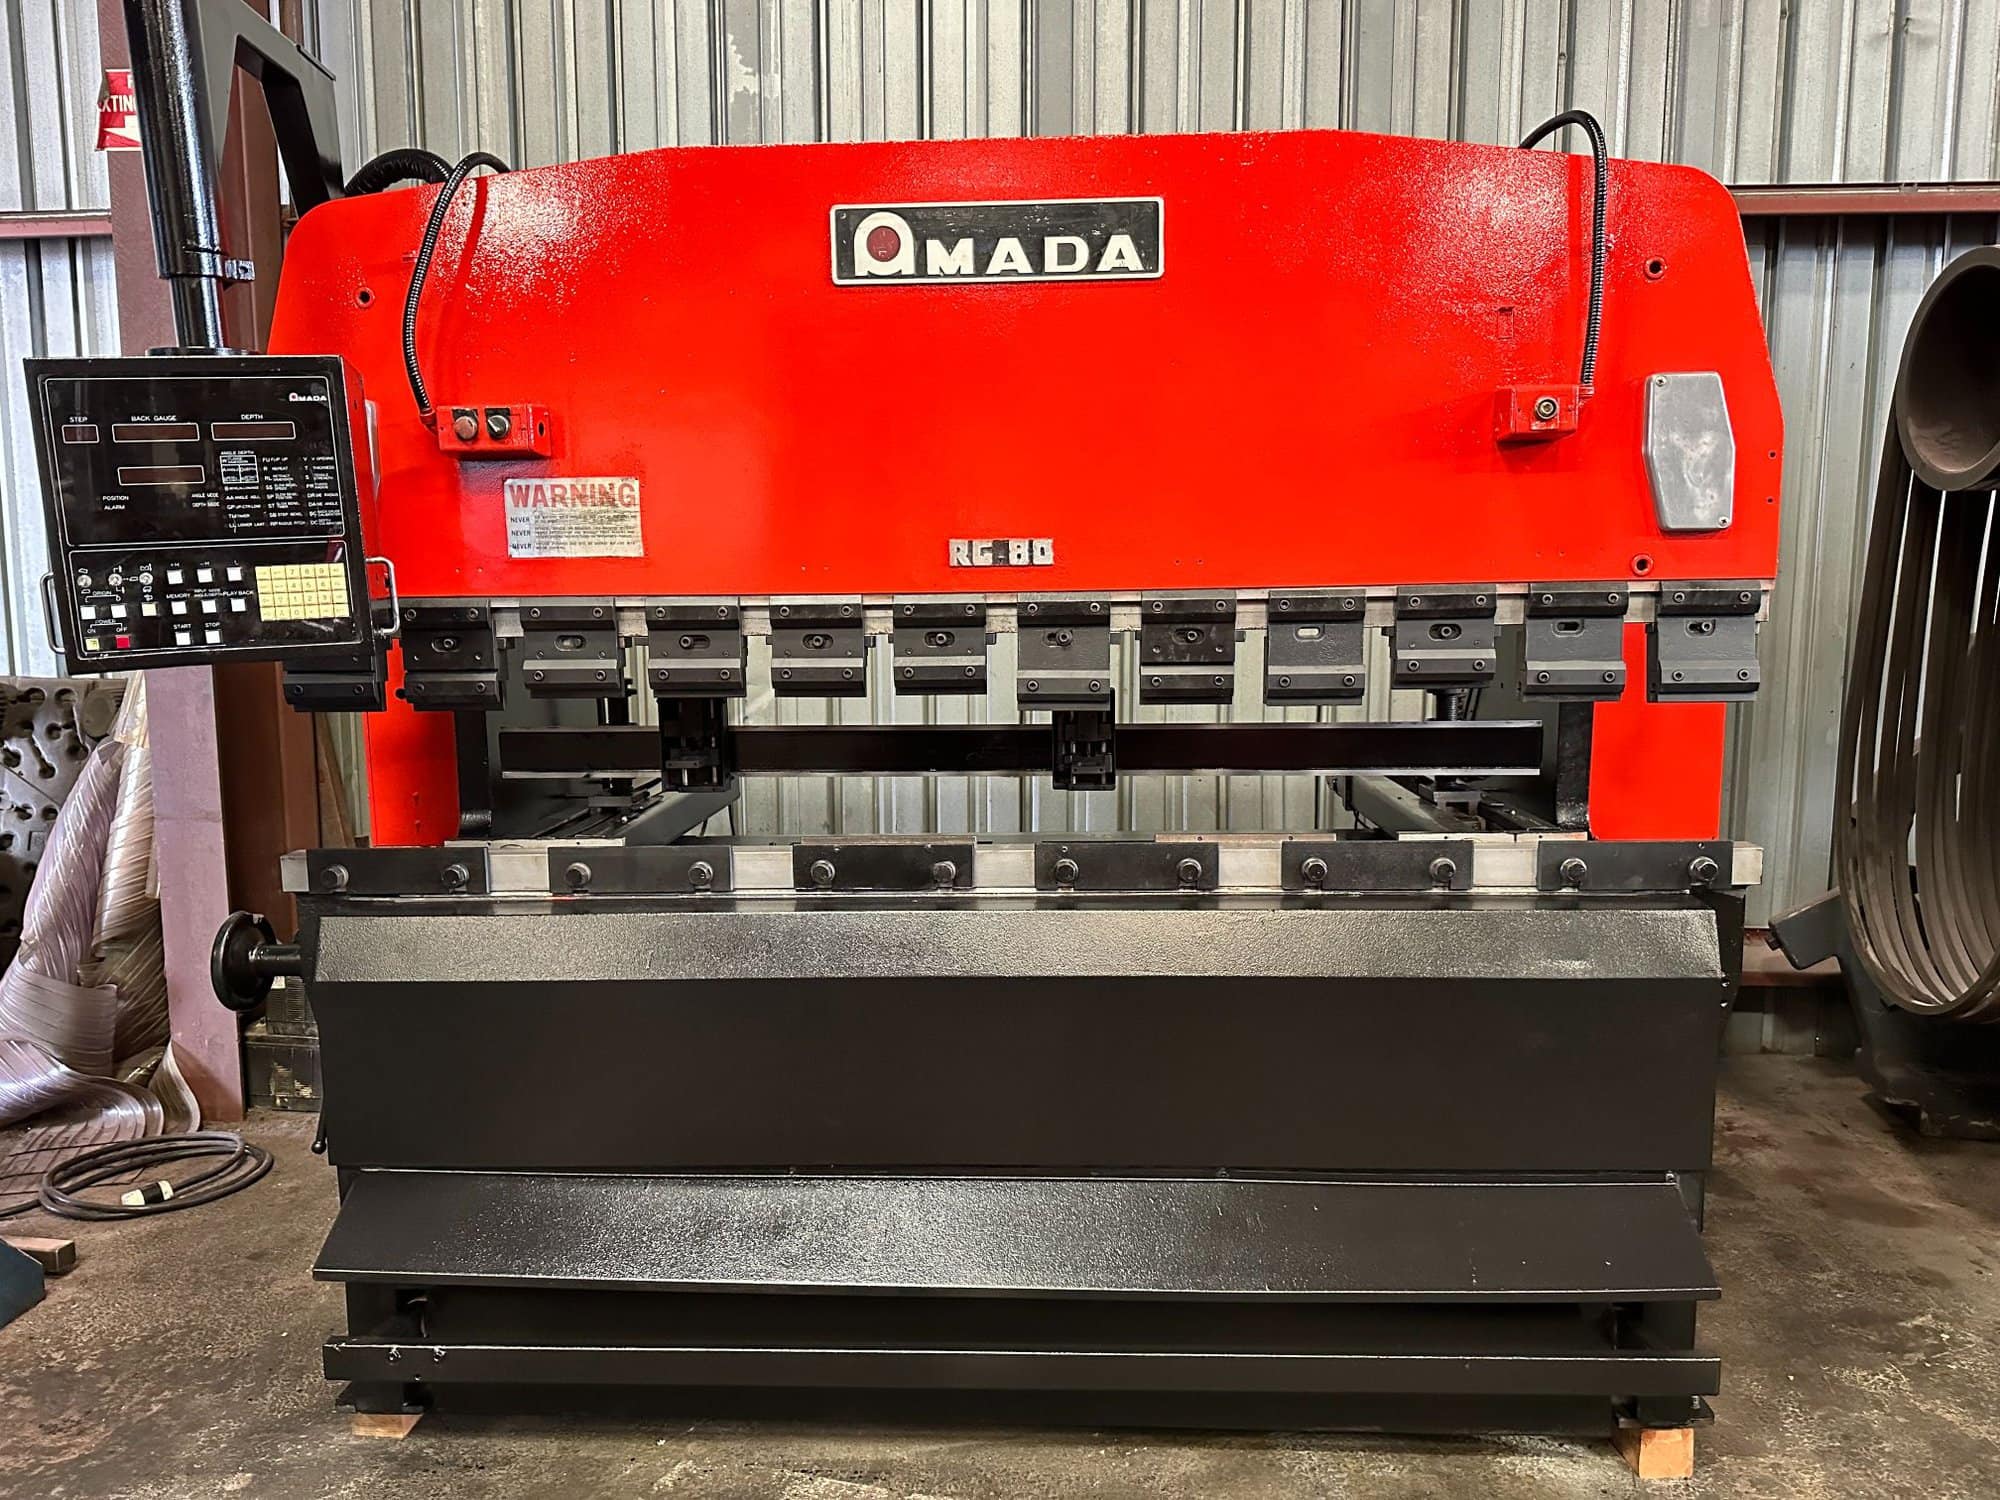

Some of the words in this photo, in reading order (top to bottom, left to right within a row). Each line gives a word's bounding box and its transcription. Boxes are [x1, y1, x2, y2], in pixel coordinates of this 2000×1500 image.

[97, 95, 136, 112] XTIN
[854, 212, 1145, 277] AMADA
[289, 392, 327, 402] AMADA
[509, 482, 636, 509] WARNING
